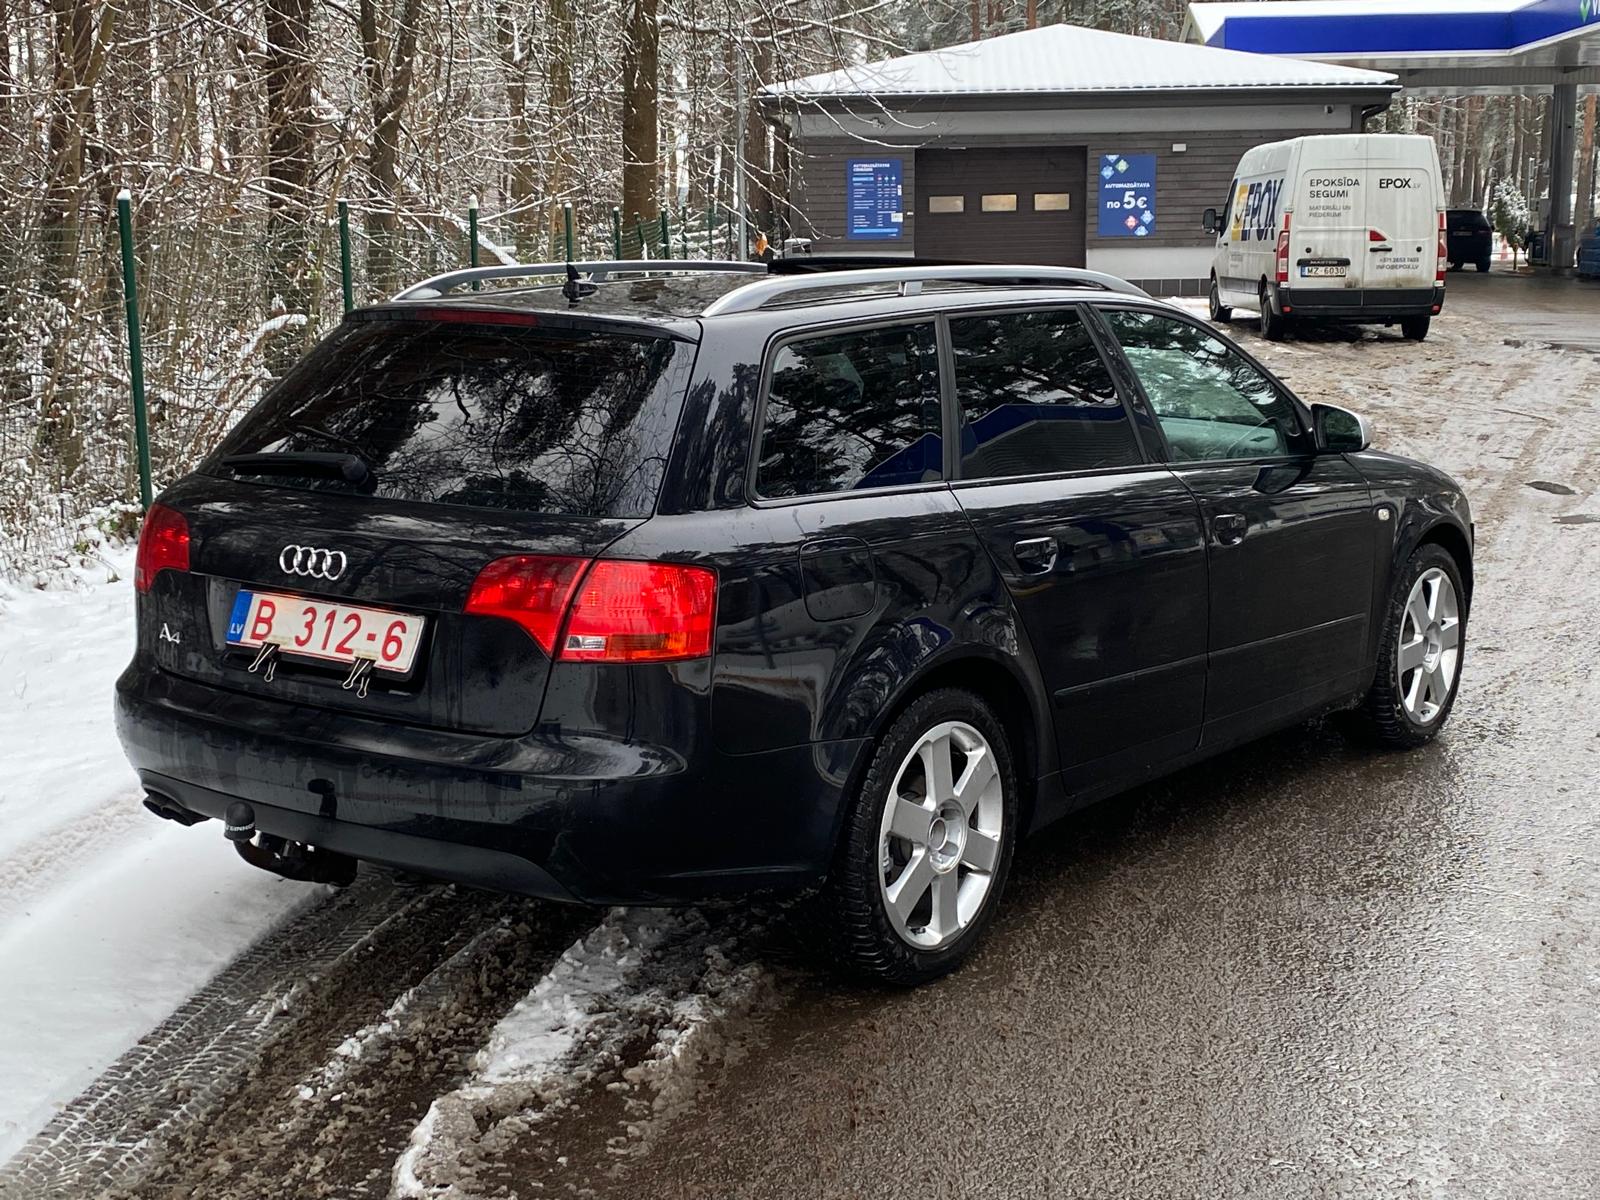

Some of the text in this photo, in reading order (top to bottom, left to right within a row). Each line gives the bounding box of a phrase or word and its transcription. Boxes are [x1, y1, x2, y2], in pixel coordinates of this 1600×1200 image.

[1309, 177, 1360, 187] EPOKSĪDA
[1106, 190, 1148, 209] no 5€
[1309, 190, 1348, 198] SEGUMI
[1241, 178, 1284, 241] EPOX
[159, 622, 181, 645] A4
[229, 621, 245, 635] LV
[250, 599, 408, 662] B 312-6
